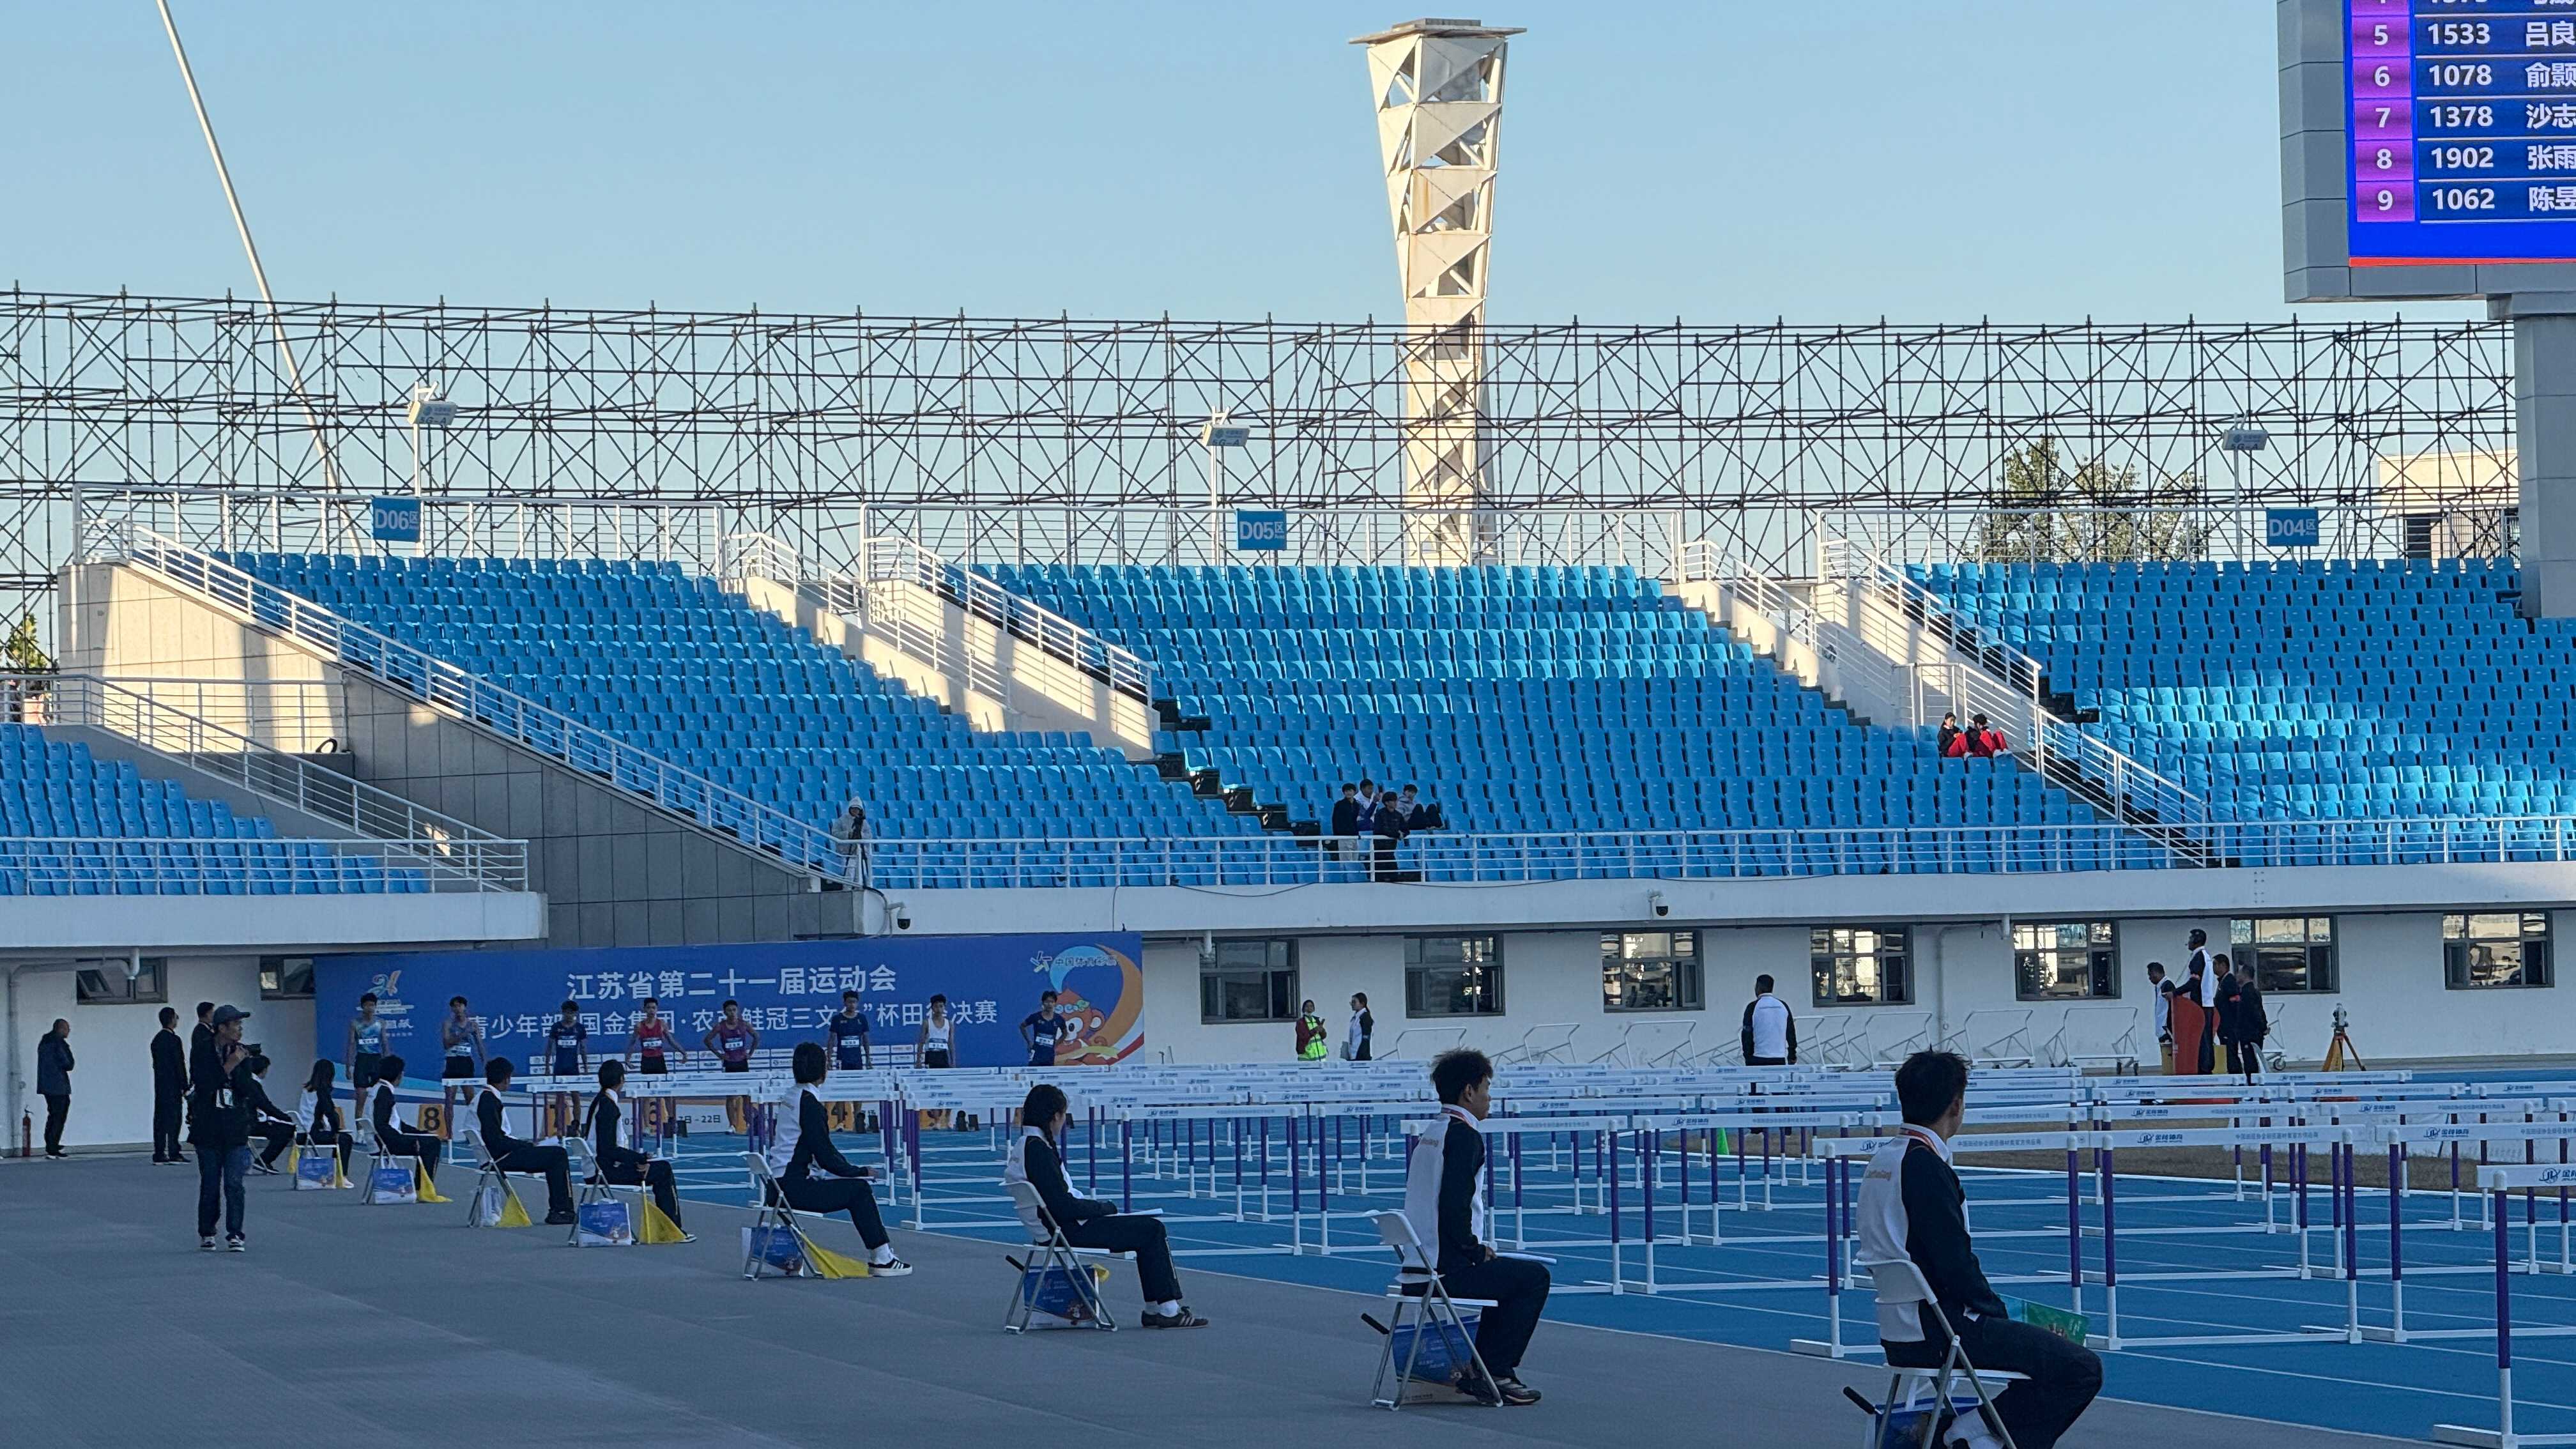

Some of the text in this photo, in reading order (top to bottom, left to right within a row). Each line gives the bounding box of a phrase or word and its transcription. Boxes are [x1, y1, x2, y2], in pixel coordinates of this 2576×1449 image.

[2373, 20, 2576, 47] 5 1533 吕良
[2373, 65, 2390, 87] 6
[2429, 65, 2492, 86] 1078
[2375, 103, 2576, 129] 7 1378 沙志
[2376, 144, 2576, 171] 8 1902 张雨
[2377, 190, 2393, 211] 9
[2432, 188, 2496, 210] 1062
[567, 963, 896, 1000] 江苏省第二十一届运动会
[424, 1107, 440, 1131] 8
